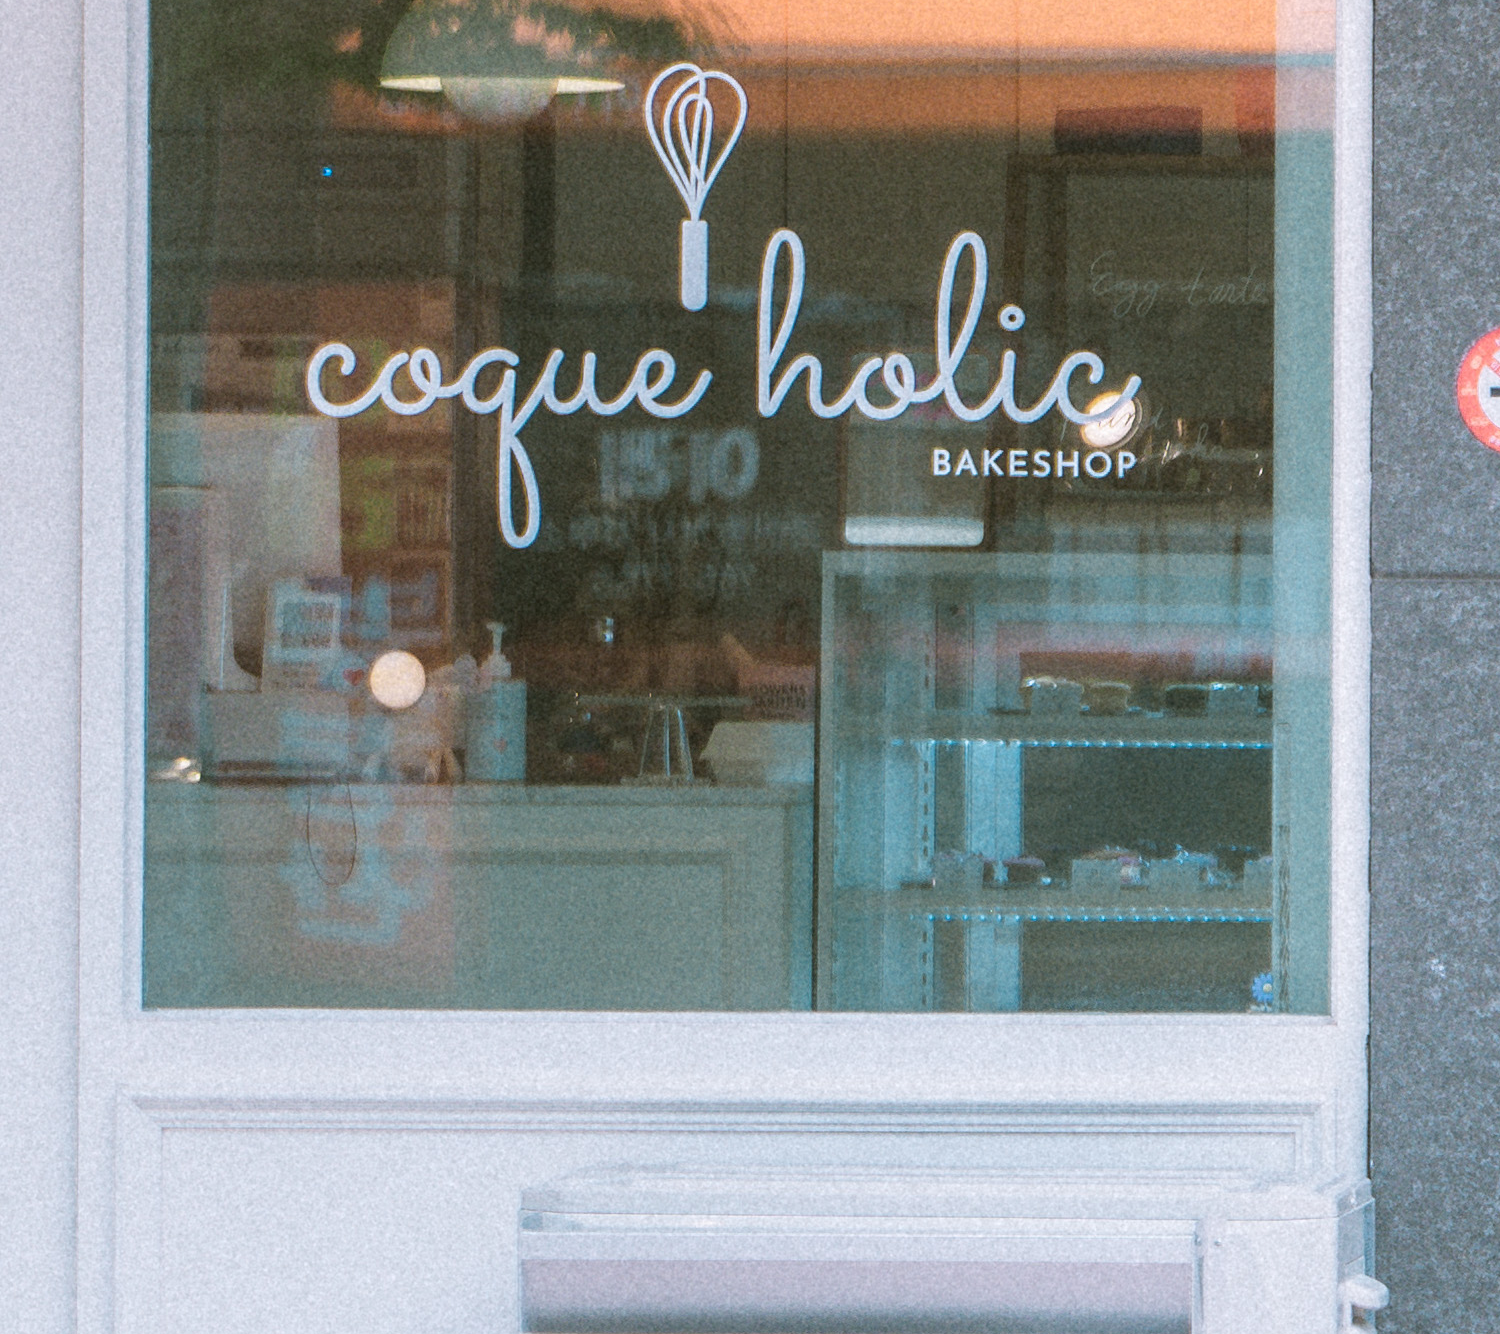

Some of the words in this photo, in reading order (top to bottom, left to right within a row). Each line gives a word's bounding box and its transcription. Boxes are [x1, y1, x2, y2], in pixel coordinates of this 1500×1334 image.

[306, 342, 712, 549] coque
[757, 230, 1141, 424] holic
[931, 448, 1138, 480] BAKESHOP
